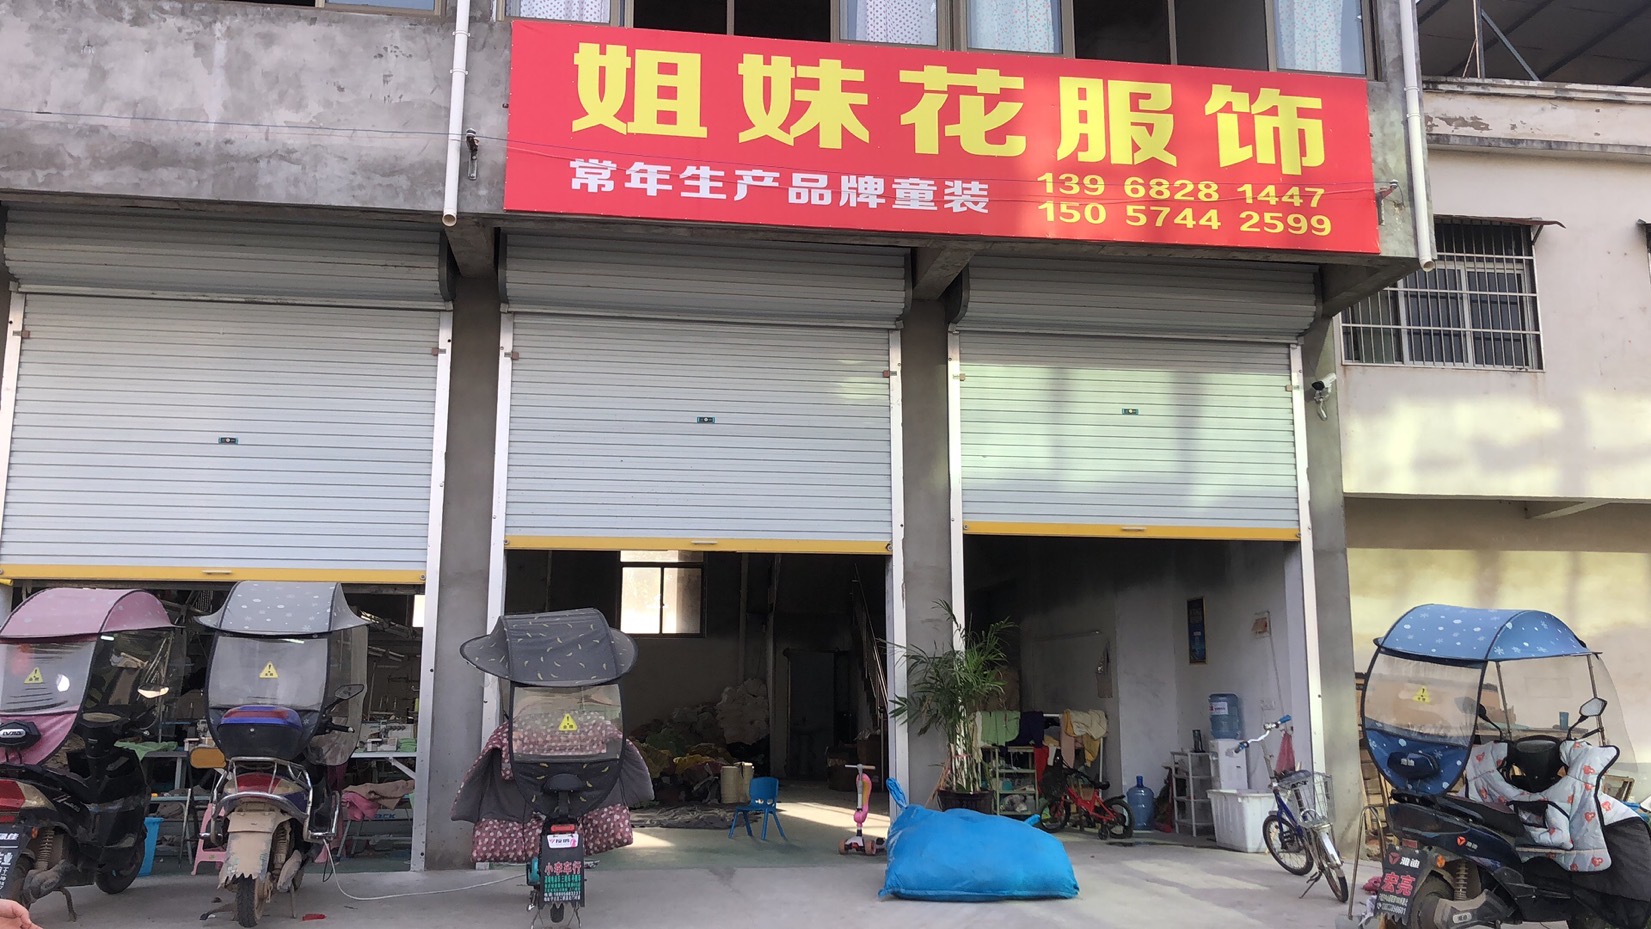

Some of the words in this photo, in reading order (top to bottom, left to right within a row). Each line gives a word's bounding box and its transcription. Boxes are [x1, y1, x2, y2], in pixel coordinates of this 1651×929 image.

[573, 43, 1324, 175] 姐妹花服饰
[570, 159, 989, 213] 常年生产品牌童装
[1037, 172, 1105, 196] 139
[1123, 176, 1220, 202] 6828
[1237, 183, 1325, 208] 1447
[1038, 200, 1107, 225] 150
[1125, 205, 1222, 230] 5744
[1239, 211, 1332, 236] 2599
[1381, 871, 1416, 897] 宏亮
